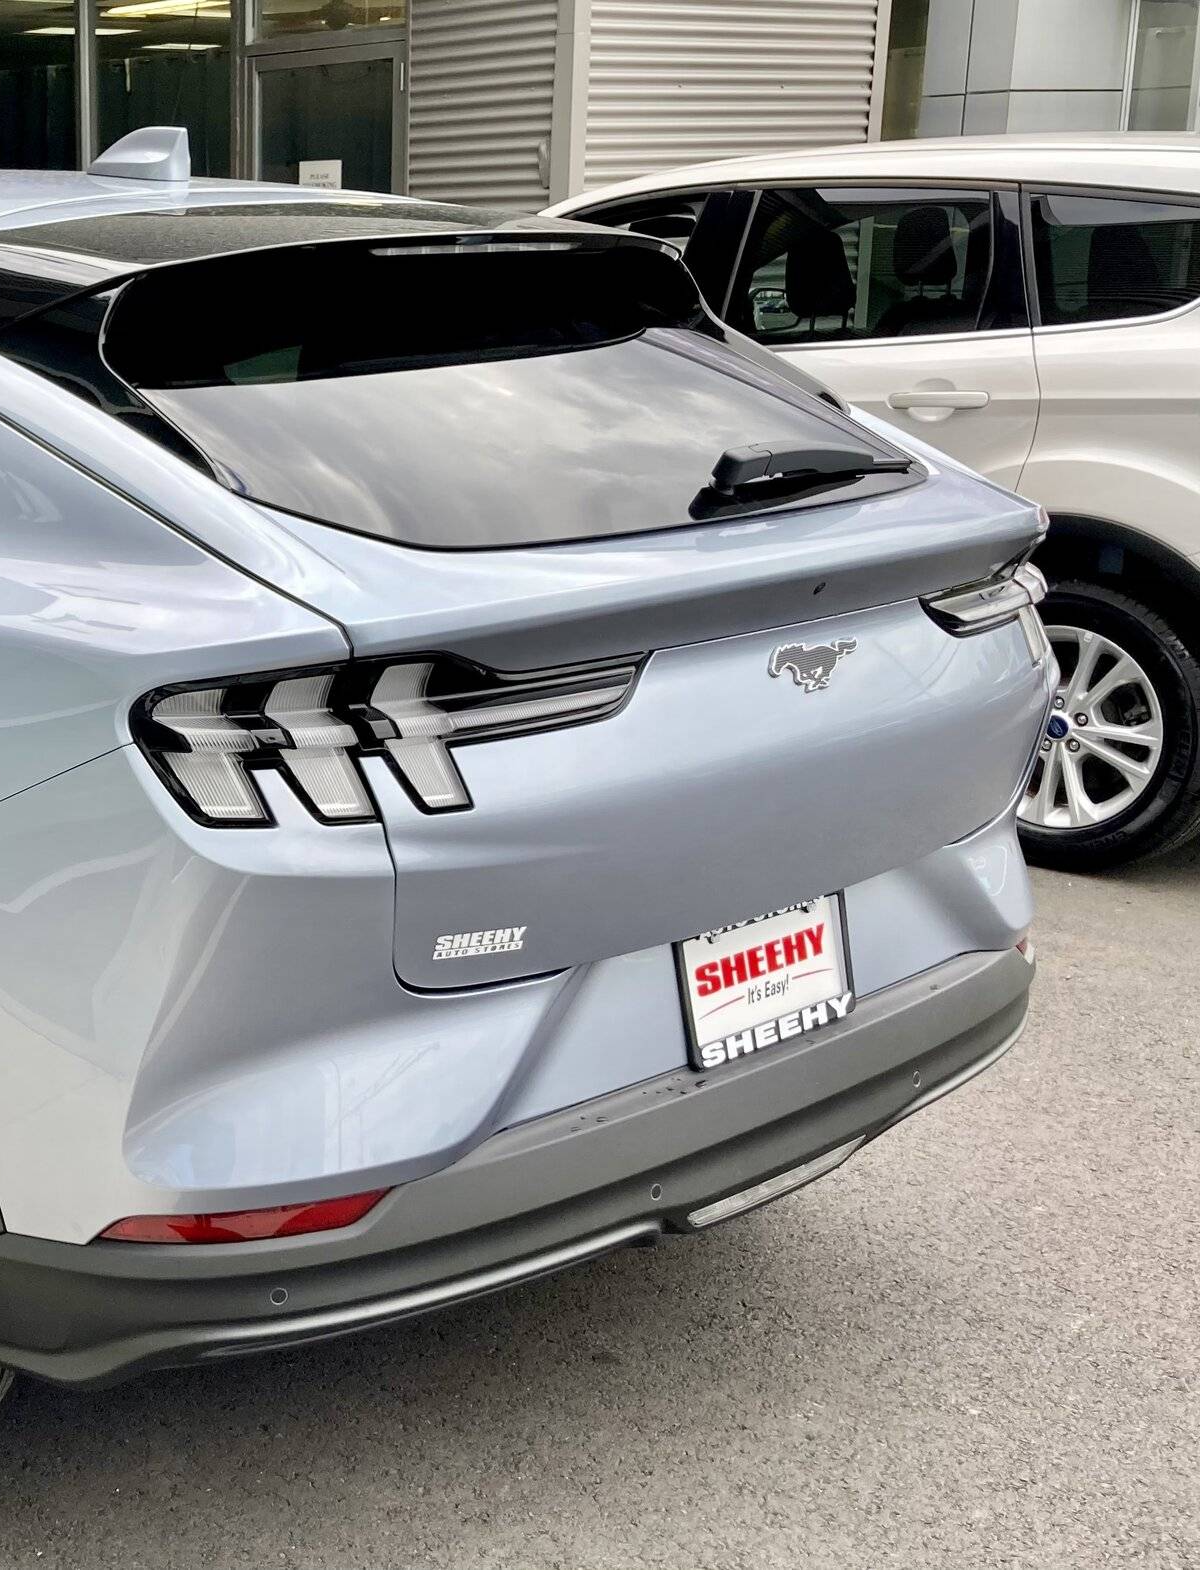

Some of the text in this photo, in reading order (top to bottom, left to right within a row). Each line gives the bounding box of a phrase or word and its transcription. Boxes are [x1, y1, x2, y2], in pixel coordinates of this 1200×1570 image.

[435, 926, 528, 950] SHEEHY
[436, 942, 520, 958] AUTO STORES
[695, 923, 824, 997] SHEEHY
[747, 974, 789, 1005] It's Easy!
[702, 992, 853, 1068] SHEEHY
